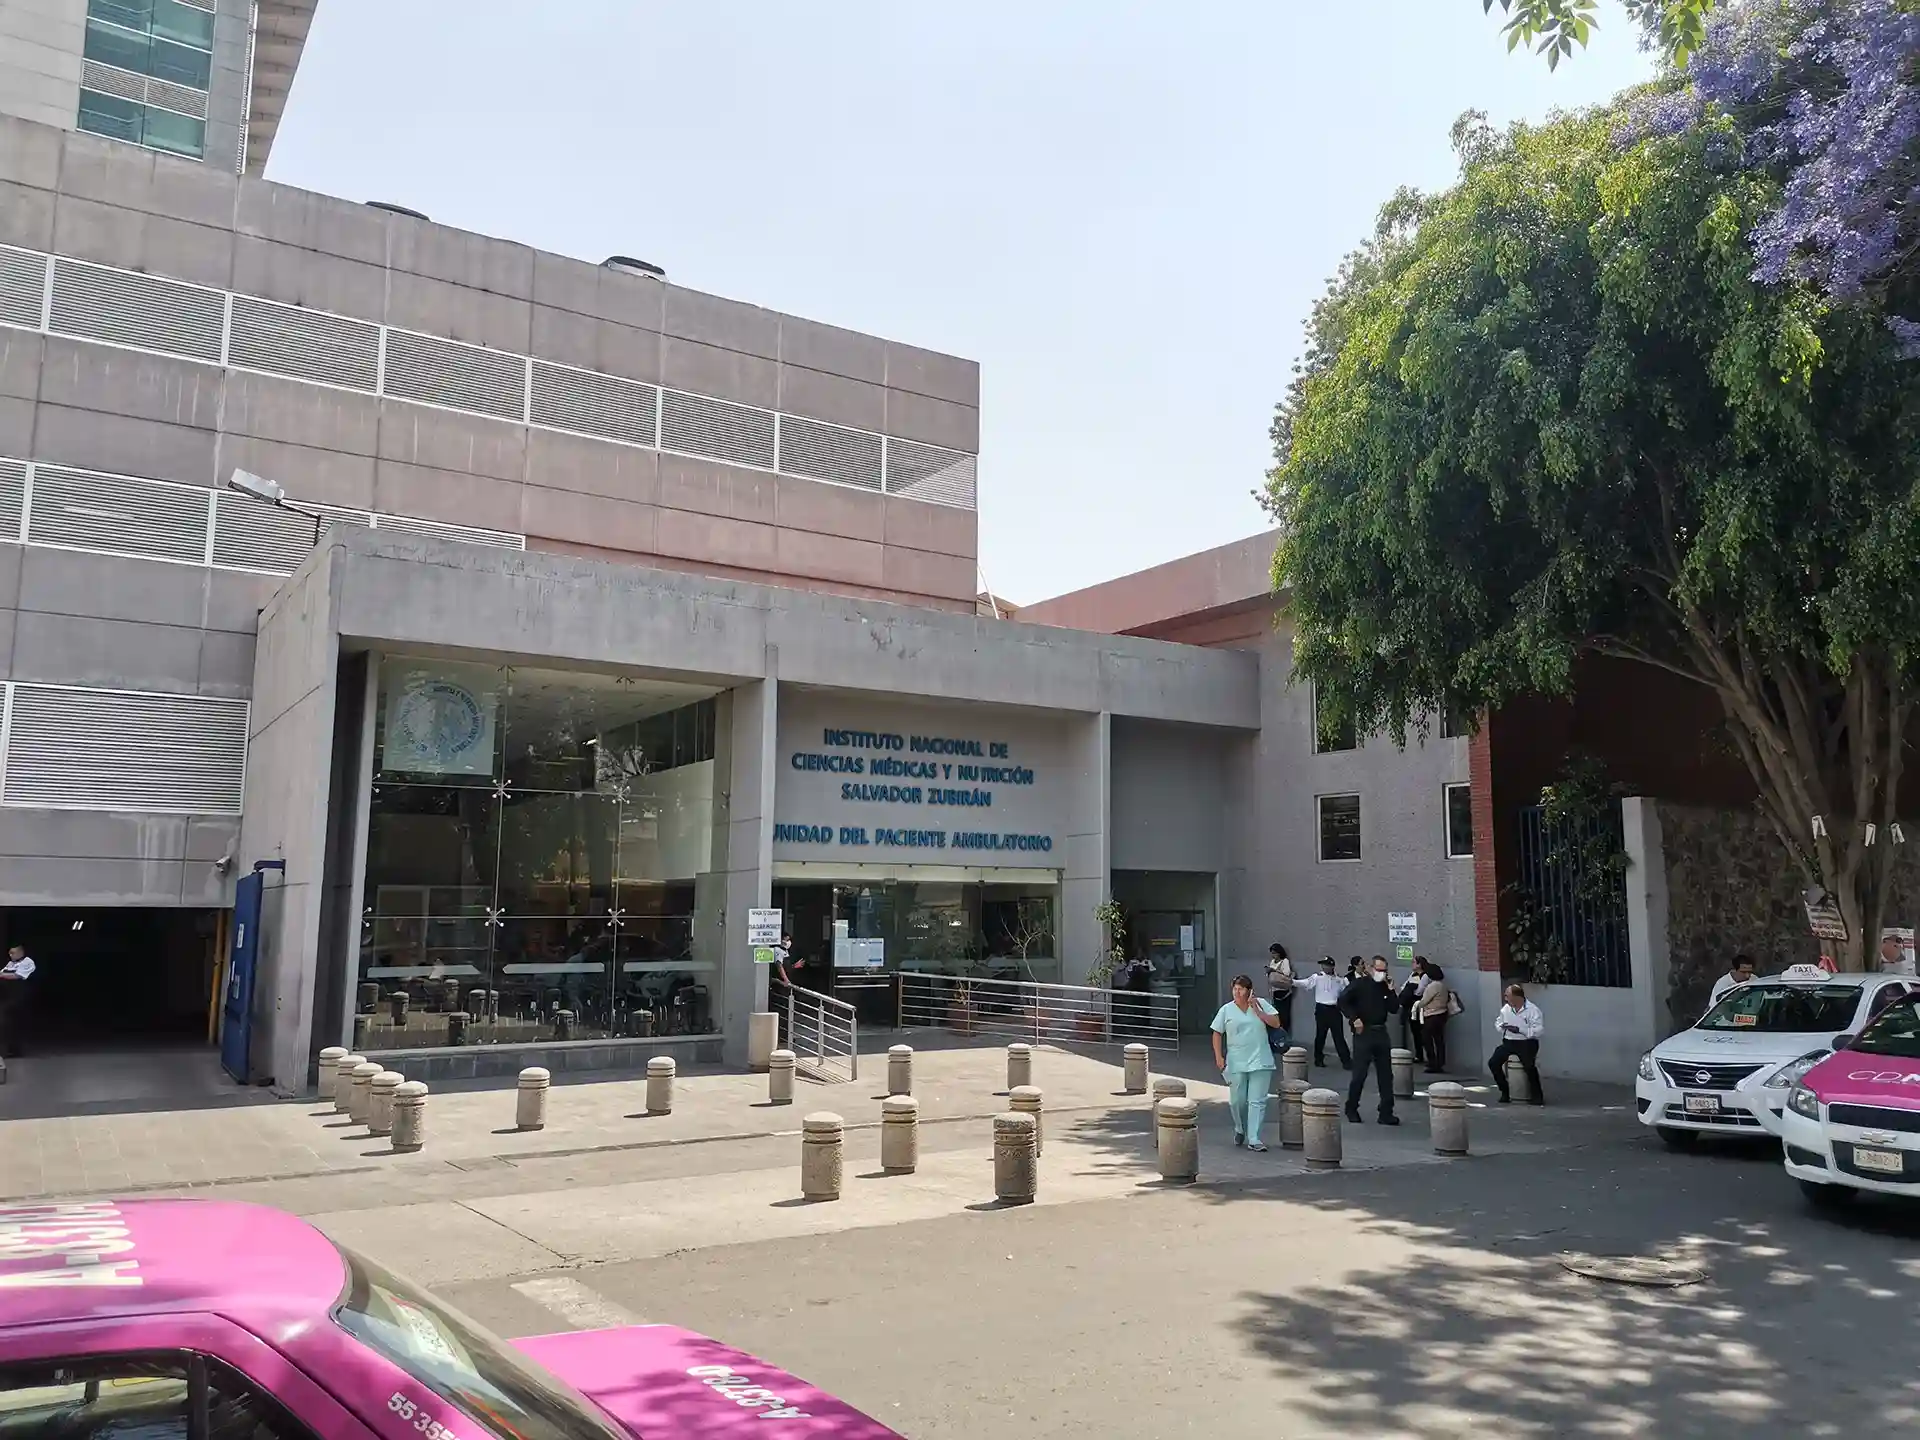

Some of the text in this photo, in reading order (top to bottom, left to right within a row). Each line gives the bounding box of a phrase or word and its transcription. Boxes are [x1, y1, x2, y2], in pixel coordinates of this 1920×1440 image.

[823, 728, 1008, 759] INSTITUTO NACIONAL DE
[791, 752, 1034, 785] CIENCIAS MÉDICAS Y NUTRICIÓN
[841, 782, 992, 807] SALVADOR ZUBIRÁN
[839, 826, 870, 845] DEL
[875, 828, 946, 848] PACIENTE
[951, 831, 1053, 852] AMBULATORIO
[1793, 965, 1813, 973] TAXI
[387, 1391, 418, 1420] 55
